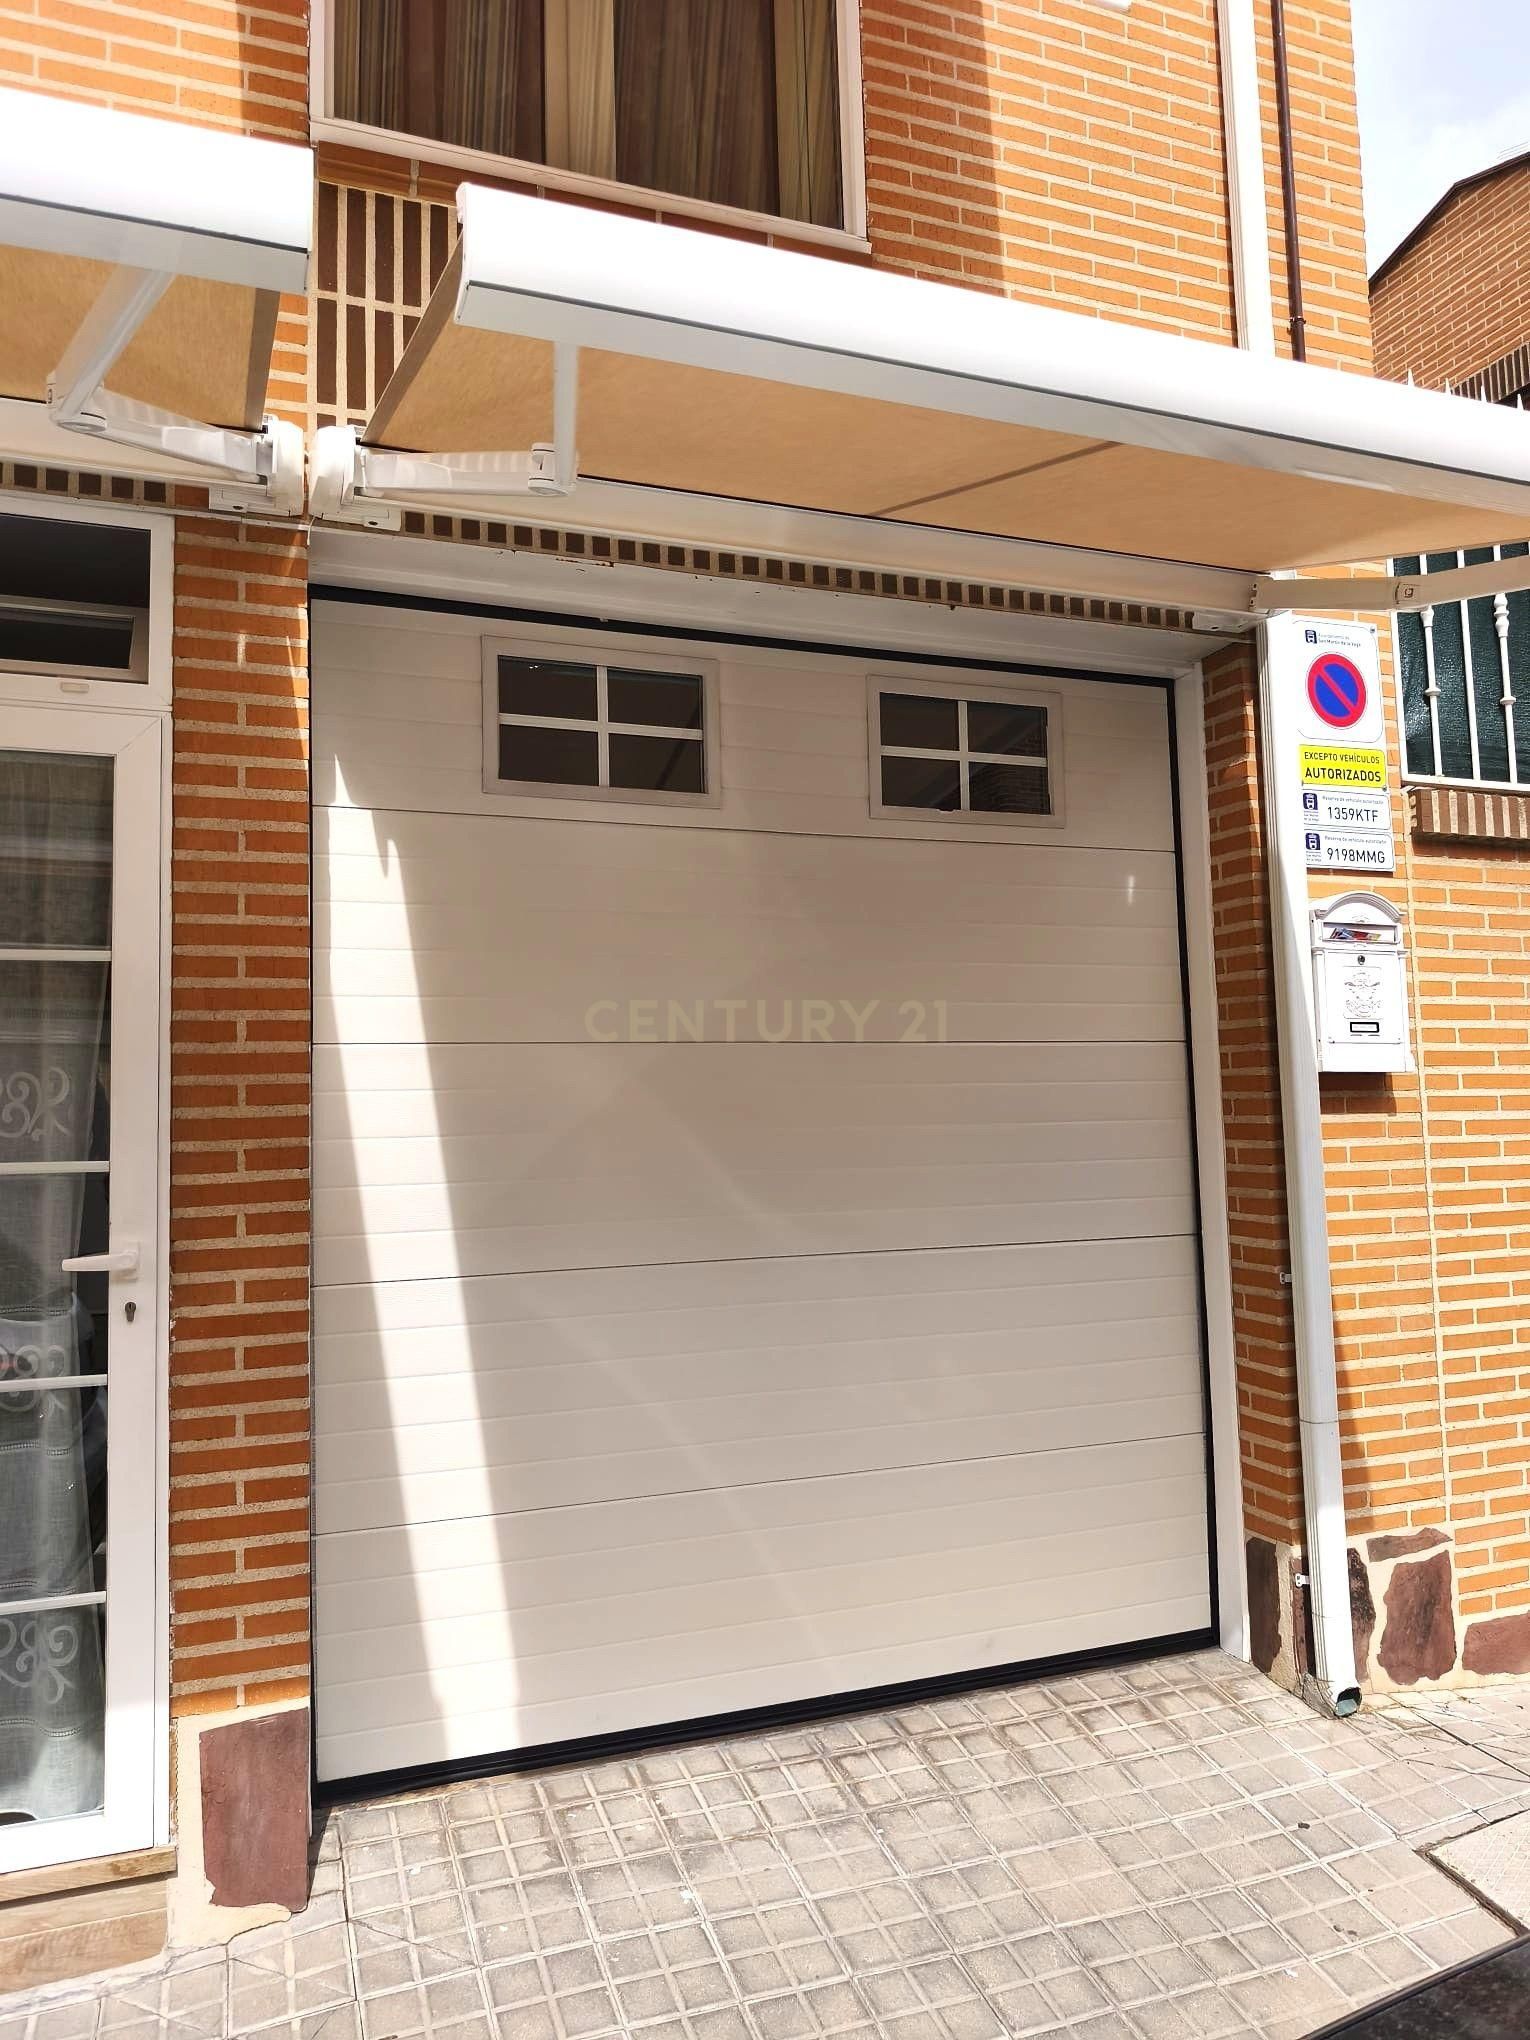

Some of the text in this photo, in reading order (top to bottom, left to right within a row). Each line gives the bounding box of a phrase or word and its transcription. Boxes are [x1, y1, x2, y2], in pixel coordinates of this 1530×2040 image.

[1304, 751, 1380, 764] EXCEPTO VEHÍCULOS
[1305, 767, 1381, 782] AUTORIZADOS
[1327, 806, 1379, 822] 1359KTF
[1326, 847, 1385, 864] 9198MMG
